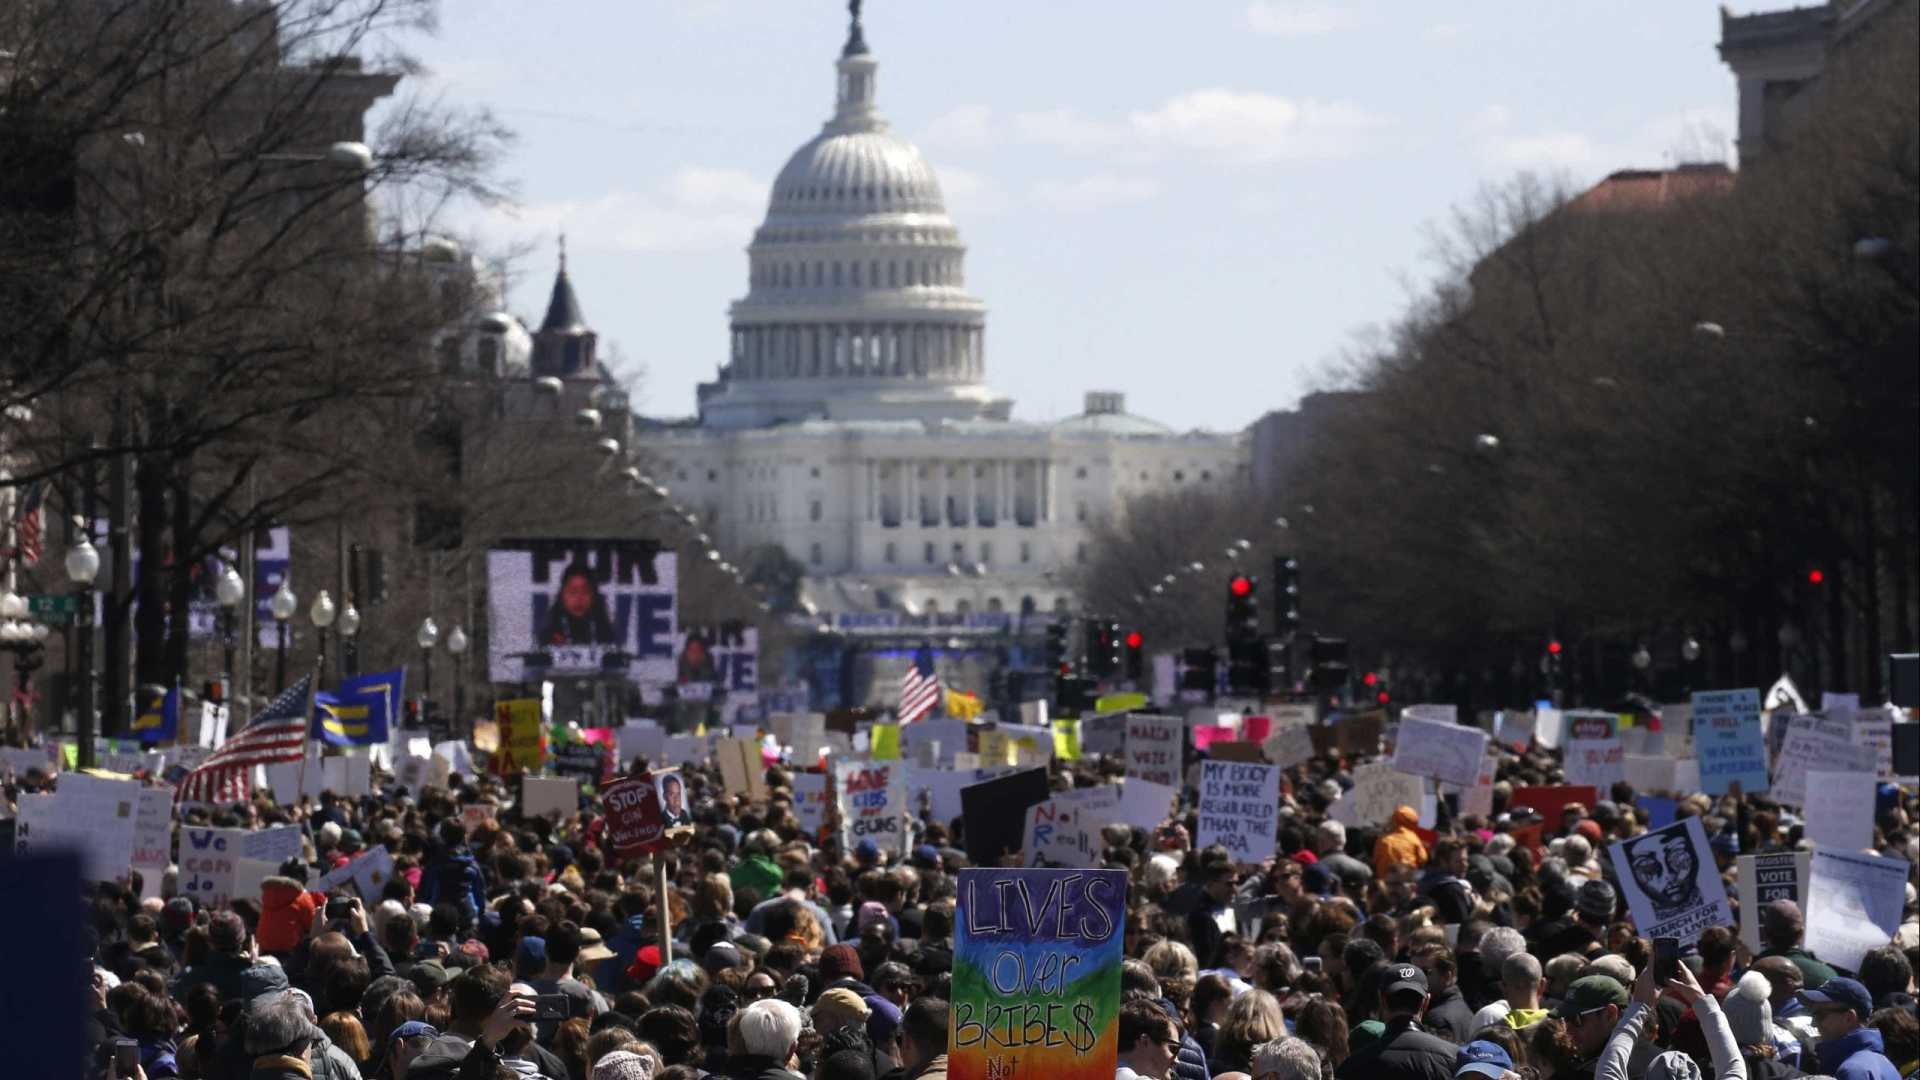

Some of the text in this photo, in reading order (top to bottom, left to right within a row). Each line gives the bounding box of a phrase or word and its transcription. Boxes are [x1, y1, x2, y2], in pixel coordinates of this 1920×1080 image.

[1204, 763, 1270, 782] MY BODY
[1206, 781, 1262, 798] IS MORE
[609, 788, 648, 812] STOP
[853, 816, 897, 836] GUNS
[1202, 816, 1271, 836] THAN THE
[188, 830, 227, 852] We
[186, 873, 213, 891] do
[1760, 870, 1792, 882] VOTE
[1765, 888, 1790, 900] FOR
[967, 874, 1113, 941] LIVES
[1649, 903, 1719, 938] MARCH FOR
[1684, 914, 1718, 935] LIVES
[955, 1000, 1097, 1056] BRIBE$
